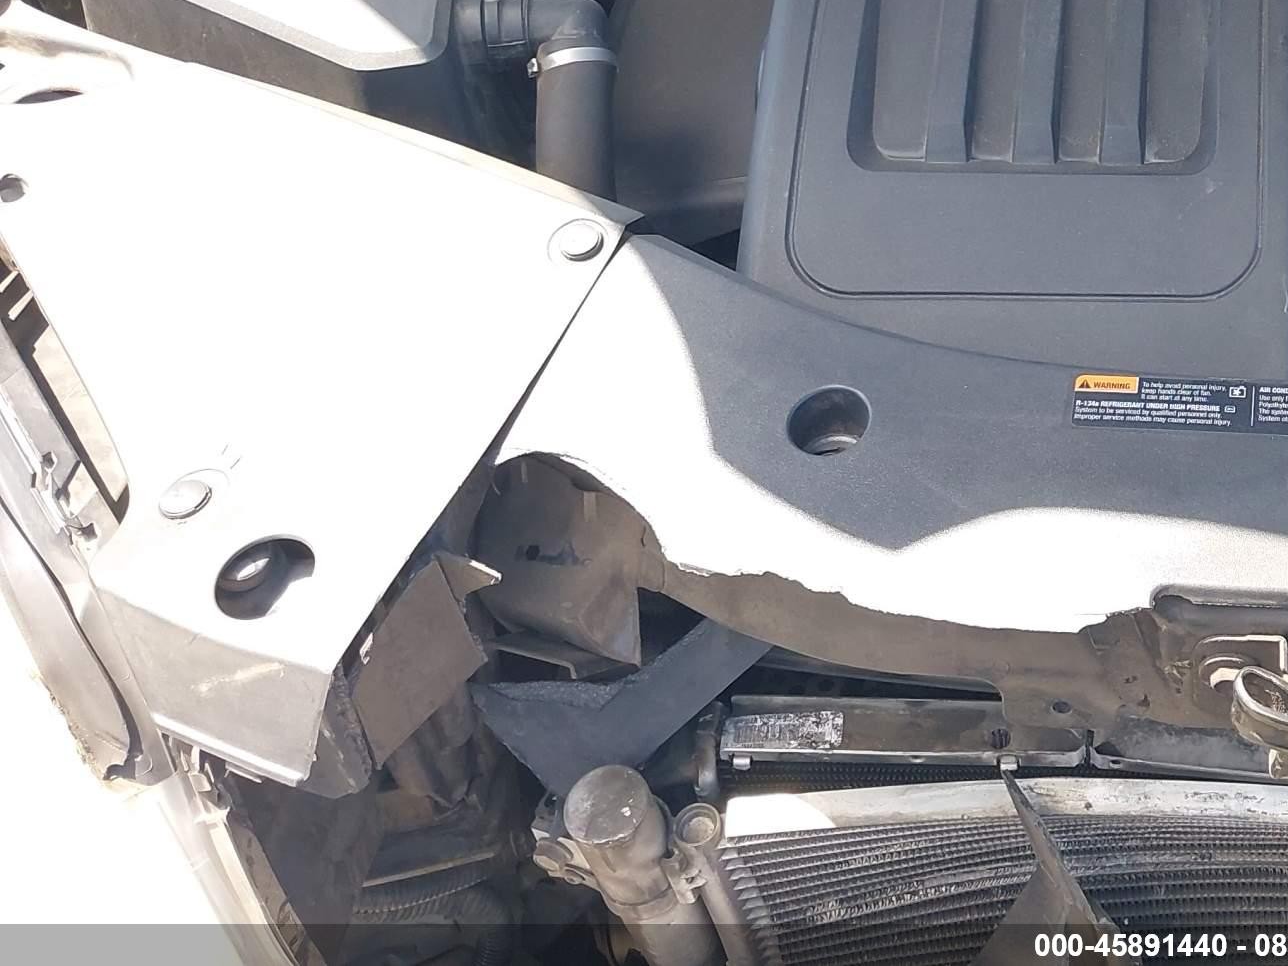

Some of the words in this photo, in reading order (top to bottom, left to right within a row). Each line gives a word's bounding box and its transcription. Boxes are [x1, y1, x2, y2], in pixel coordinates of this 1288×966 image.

[1093, 381, 1131, 389] WARNING
[1182, 382, 1208, 390] personal
[1076, 399, 1100, 407] R-134a
[1101, 400, 1144, 409] REFRIGERANT
[1187, 404, 1220, 412] PRESSURE
[1187, 417, 1213, 425] personal
